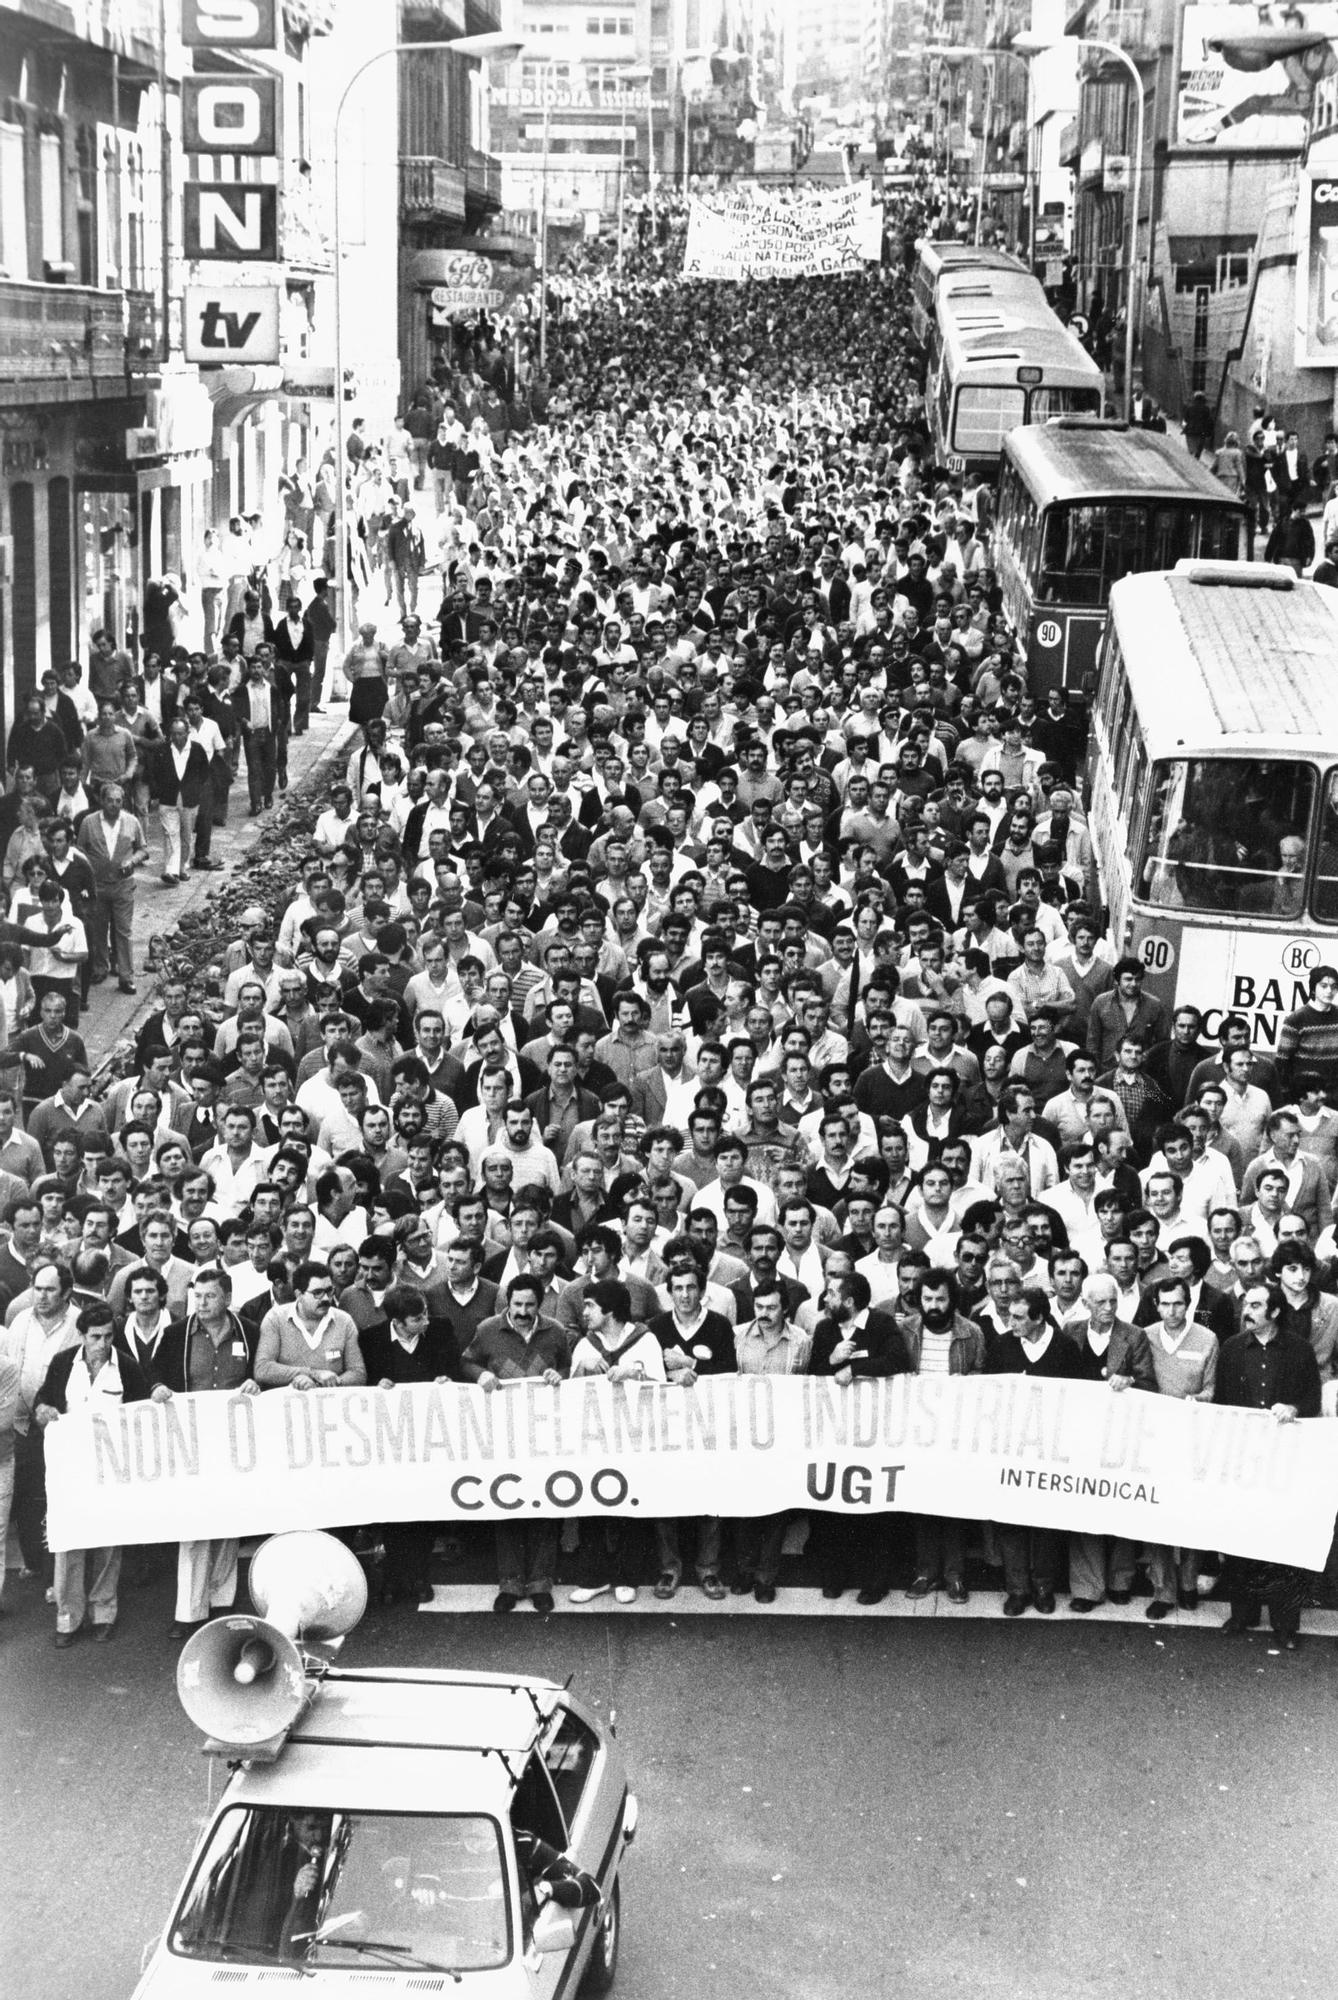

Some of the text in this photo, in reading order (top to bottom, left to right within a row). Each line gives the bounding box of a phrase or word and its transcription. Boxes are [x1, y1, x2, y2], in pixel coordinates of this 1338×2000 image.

[433, 289, 503, 304] RESTAURANTE
[199, 301, 262, 349] tv
[1041, 625, 1056, 642] 90
[1143, 939, 1169, 969] 90
[1290, 947, 1314, 970] BC
[92, 1373, 1304, 1493] NON O DESMANTELAMENTO INDUSTRIAL DE VIGO
[450, 1462, 1160, 1510] CC.OO. UGT INTERSINDICAL
